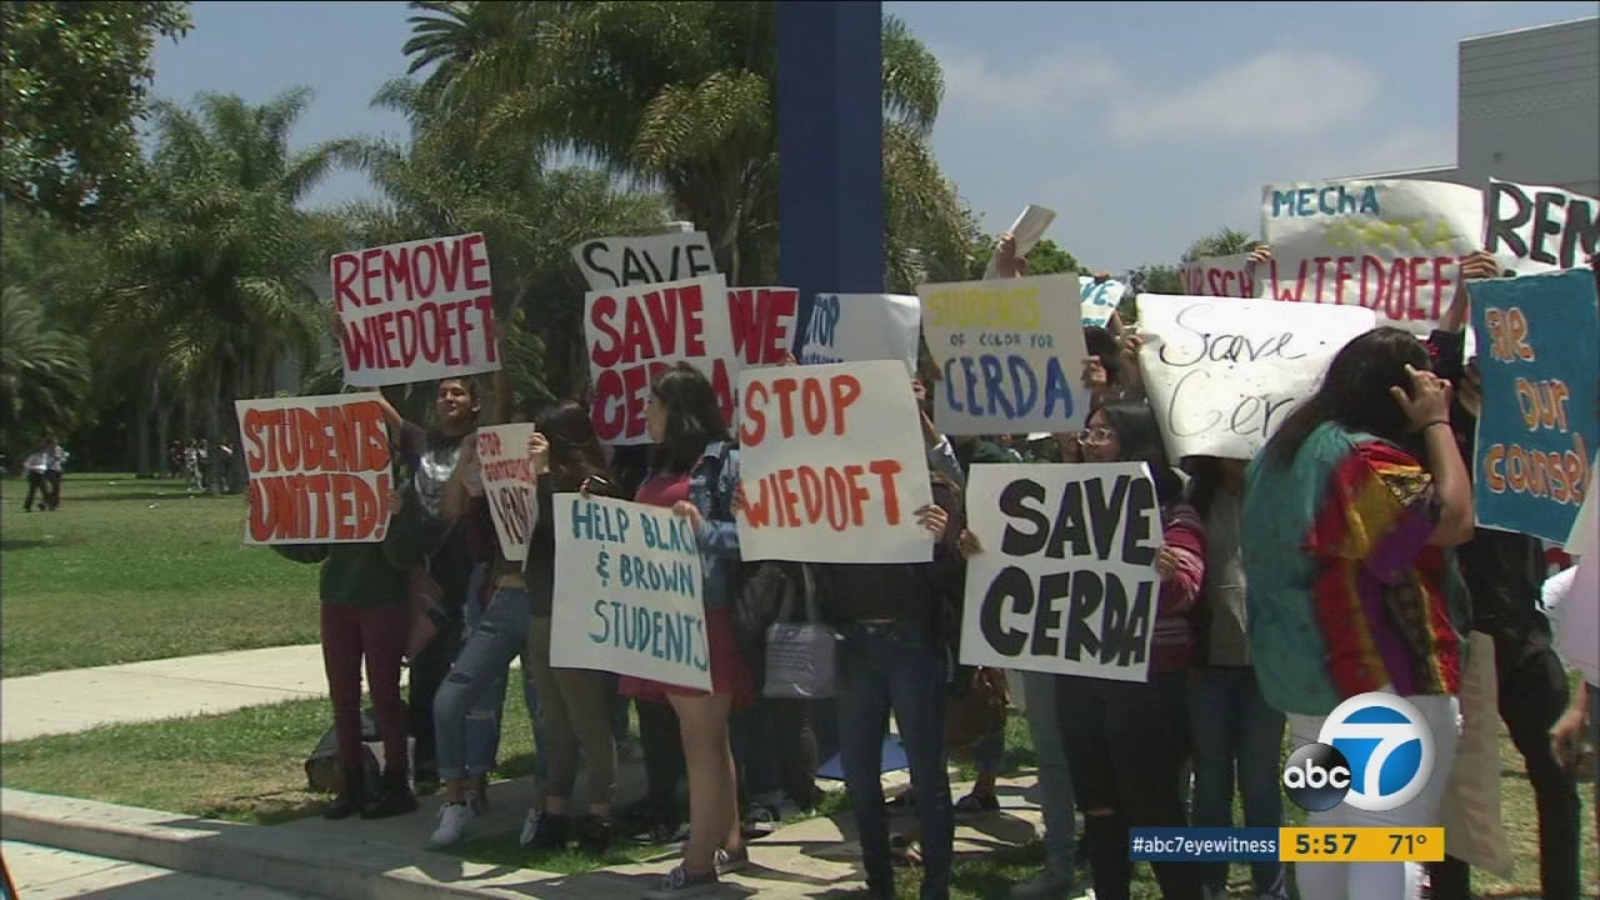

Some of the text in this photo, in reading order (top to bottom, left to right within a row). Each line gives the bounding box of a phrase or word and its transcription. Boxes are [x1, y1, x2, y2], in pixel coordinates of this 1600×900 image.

[333, 235, 489, 311] REMOVE
[582, 241, 711, 287] SAVE
[339, 295, 496, 372] WIEDOEFT
[591, 284, 706, 368] SAVE
[727, 289, 797, 365] WE
[949, 333, 1054, 348] OF COLOR FOR
[1159, 303, 1306, 367] Save
[739, 374, 861, 447] STOP
[944, 354, 1074, 420] CERDA
[244, 400, 391, 472] STUDENTS
[250, 472, 390, 542] UNITED!
[572, 499, 630, 543] HELP
[640, 512, 698, 556] BLAC
[738, 460, 903, 531] WIEDOFT
[999, 475, 1156, 566] SAVE
[596, 544, 695, 598] & BROWN
[588, 600, 708, 672] STUDENTS
[980, 565, 1154, 666] CERDA
